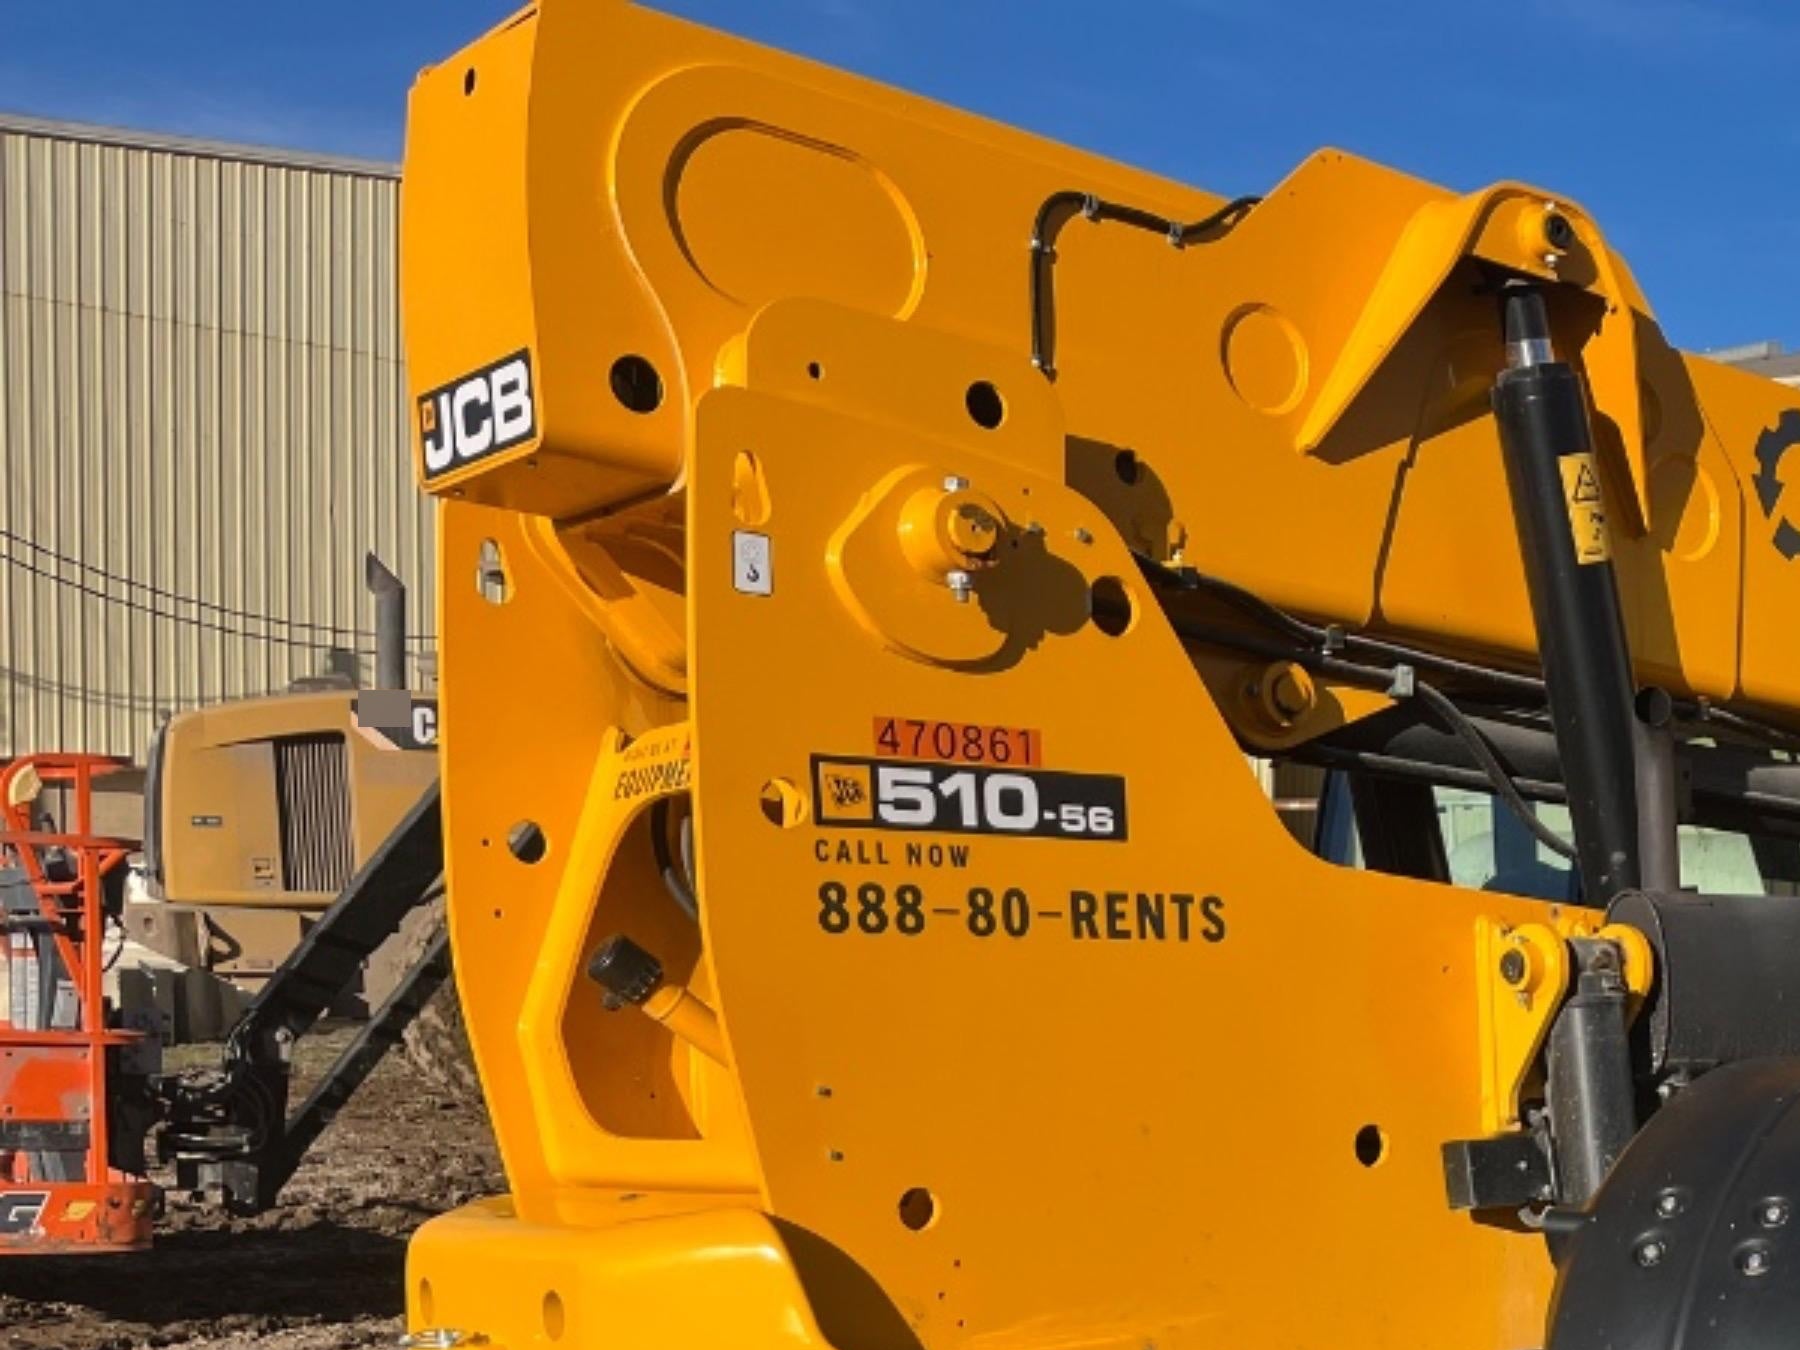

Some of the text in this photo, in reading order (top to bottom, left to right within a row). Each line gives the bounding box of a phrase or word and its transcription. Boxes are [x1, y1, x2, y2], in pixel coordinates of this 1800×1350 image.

[424, 358, 533, 472] JCB
[877, 719, 1035, 766] 470861
[815, 838, 971, 869] CALL NOW
